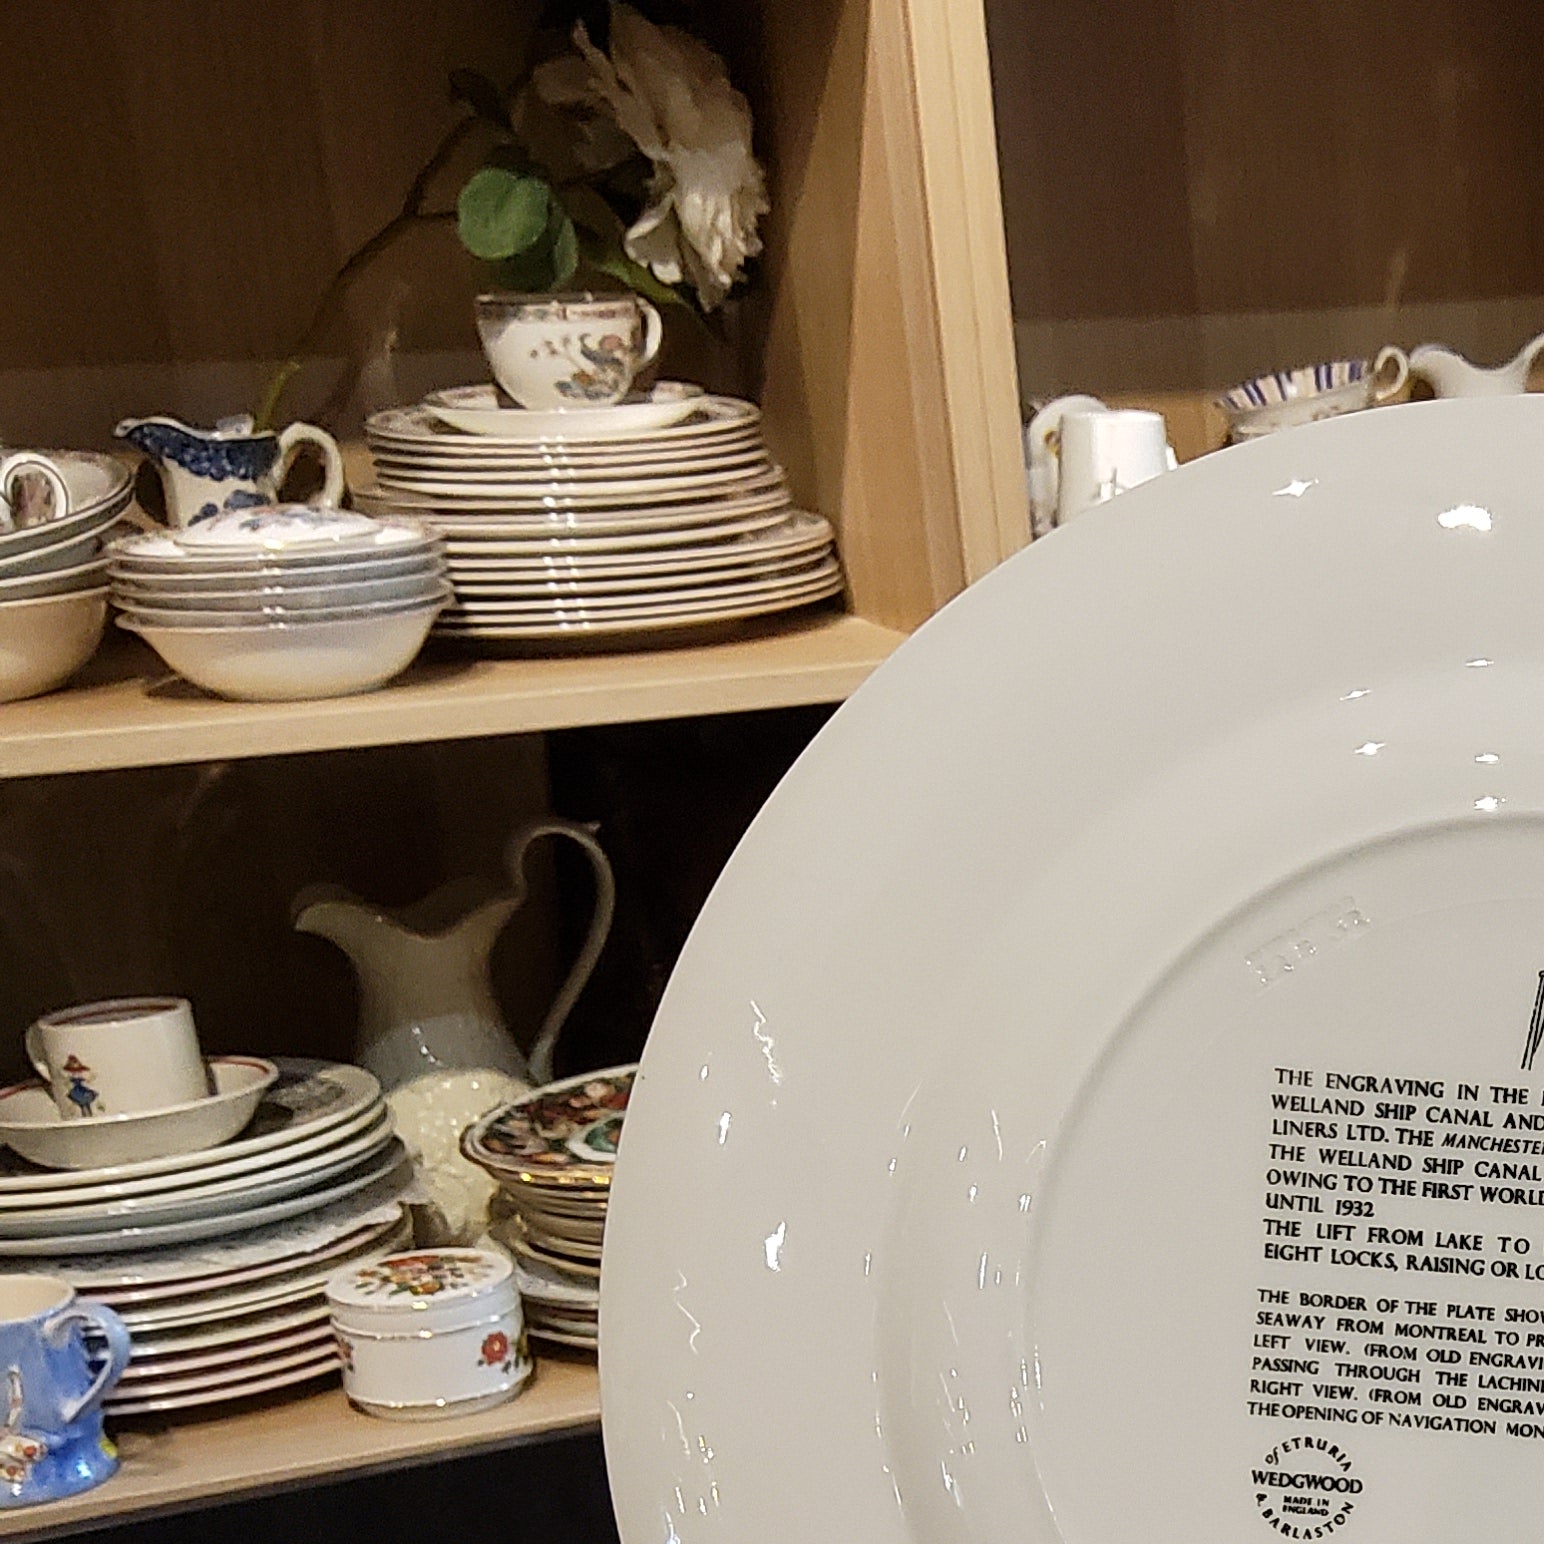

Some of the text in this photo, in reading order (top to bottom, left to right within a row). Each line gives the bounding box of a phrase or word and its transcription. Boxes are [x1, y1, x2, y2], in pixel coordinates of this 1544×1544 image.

[1275, 1068, 1313, 1087] THE
[1326, 1073, 1444, 1098] ENGRAVING
[1457, 1084, 1479, 1101] IN
[1490, 1086, 1529, 1104] THE
[1271, 1094, 1364, 1116] WELLAND
[1375, 1102, 1416, 1121] SHIP
[1426, 1106, 1493, 1127] CANAL
[1273, 1119, 1337, 1139] LINERS
[1347, 1124, 1389, 1143] LTD.
[1395, 1128, 1434, 1147] THE
[1269, 1144, 1306, 1162] THE
[1319, 1148, 1412, 1171] WELLAND
[1422, 1157, 1464, 1175] SHIP
[1475, 1161, 1542, 1181] CANAL
[1266, 1169, 1337, 1190] OWING
[1343, 1175, 1373, 1192] TO
[1378, 1177, 1417, 1196] THE
[1422, 1182, 1474, 1200] FIRST
[1266, 1193, 1374, 1217] UNTIL 1932
[1263, 1219, 1301, 1237] THE
[1317, 1223, 1356, 1241] LIFT
[1367, 1227, 1423, 1246] FROM
[1435, 1232, 1483, 1251] LAKE
[1497, 1237, 1530, 1254] TO
[1264, 1243, 1323, 1262] EIGHT
[1331, 1249, 1398, 1272] LOCKS,
[1406, 1255, 1485, 1276] RAISING
[1491, 1261, 1519, 1278] OR
[1257, 1289, 1290, 1304] THE
[1300, 1293, 1367, 1311] BORDER
[1377, 1299, 1399, 1313] OF
[1404, 1301, 1437, 1316] THE
[1447, 1304, 1495, 1321] PLATE
[1256, 1311, 1325, 1329] SEAWAY
[1336, 1318, 1384, 1335] FROM
[1395, 1323, 1487, 1344] MONTREAL
[1494, 1331, 1519, 1346] TO
[1254, 1334, 1291, 1349] LEFT
[1305, 1338, 1350, 1354] VIEW.
[1364, 1344, 1417, 1361] (FROM
[1426, 1349, 1461, 1364] OLD
[1252, 1357, 1319, 1374] PASSING
[1335, 1363, 1420, 1383] THROUGH
[1435, 1371, 1468, 1387] THE
[1250, 1379, 1303, 1396] RIGHT
[1313, 1384, 1357, 1400] VIEW.
[1369, 1388, 1421, 1406] (FROM
[1433, 1394, 1466, 1409] OLD
[1247, 1401, 1280, 1416] THE
[1281, 1404, 1358, 1423] OPENING
[1361, 1411, 1384, 1425] OF
[1389, 1413, 1496, 1434] NAVIGATION
[1282, 1436, 1352, 1472] ETRURIA
[1252, 1470, 1363, 1493] WEDGWOOD
[1282, 1505, 1329, 1516] ENGLAND
[1284, 1496, 1329, 1506] MADE IN
[1262, 1501, 1354, 1540] BARLASTON
